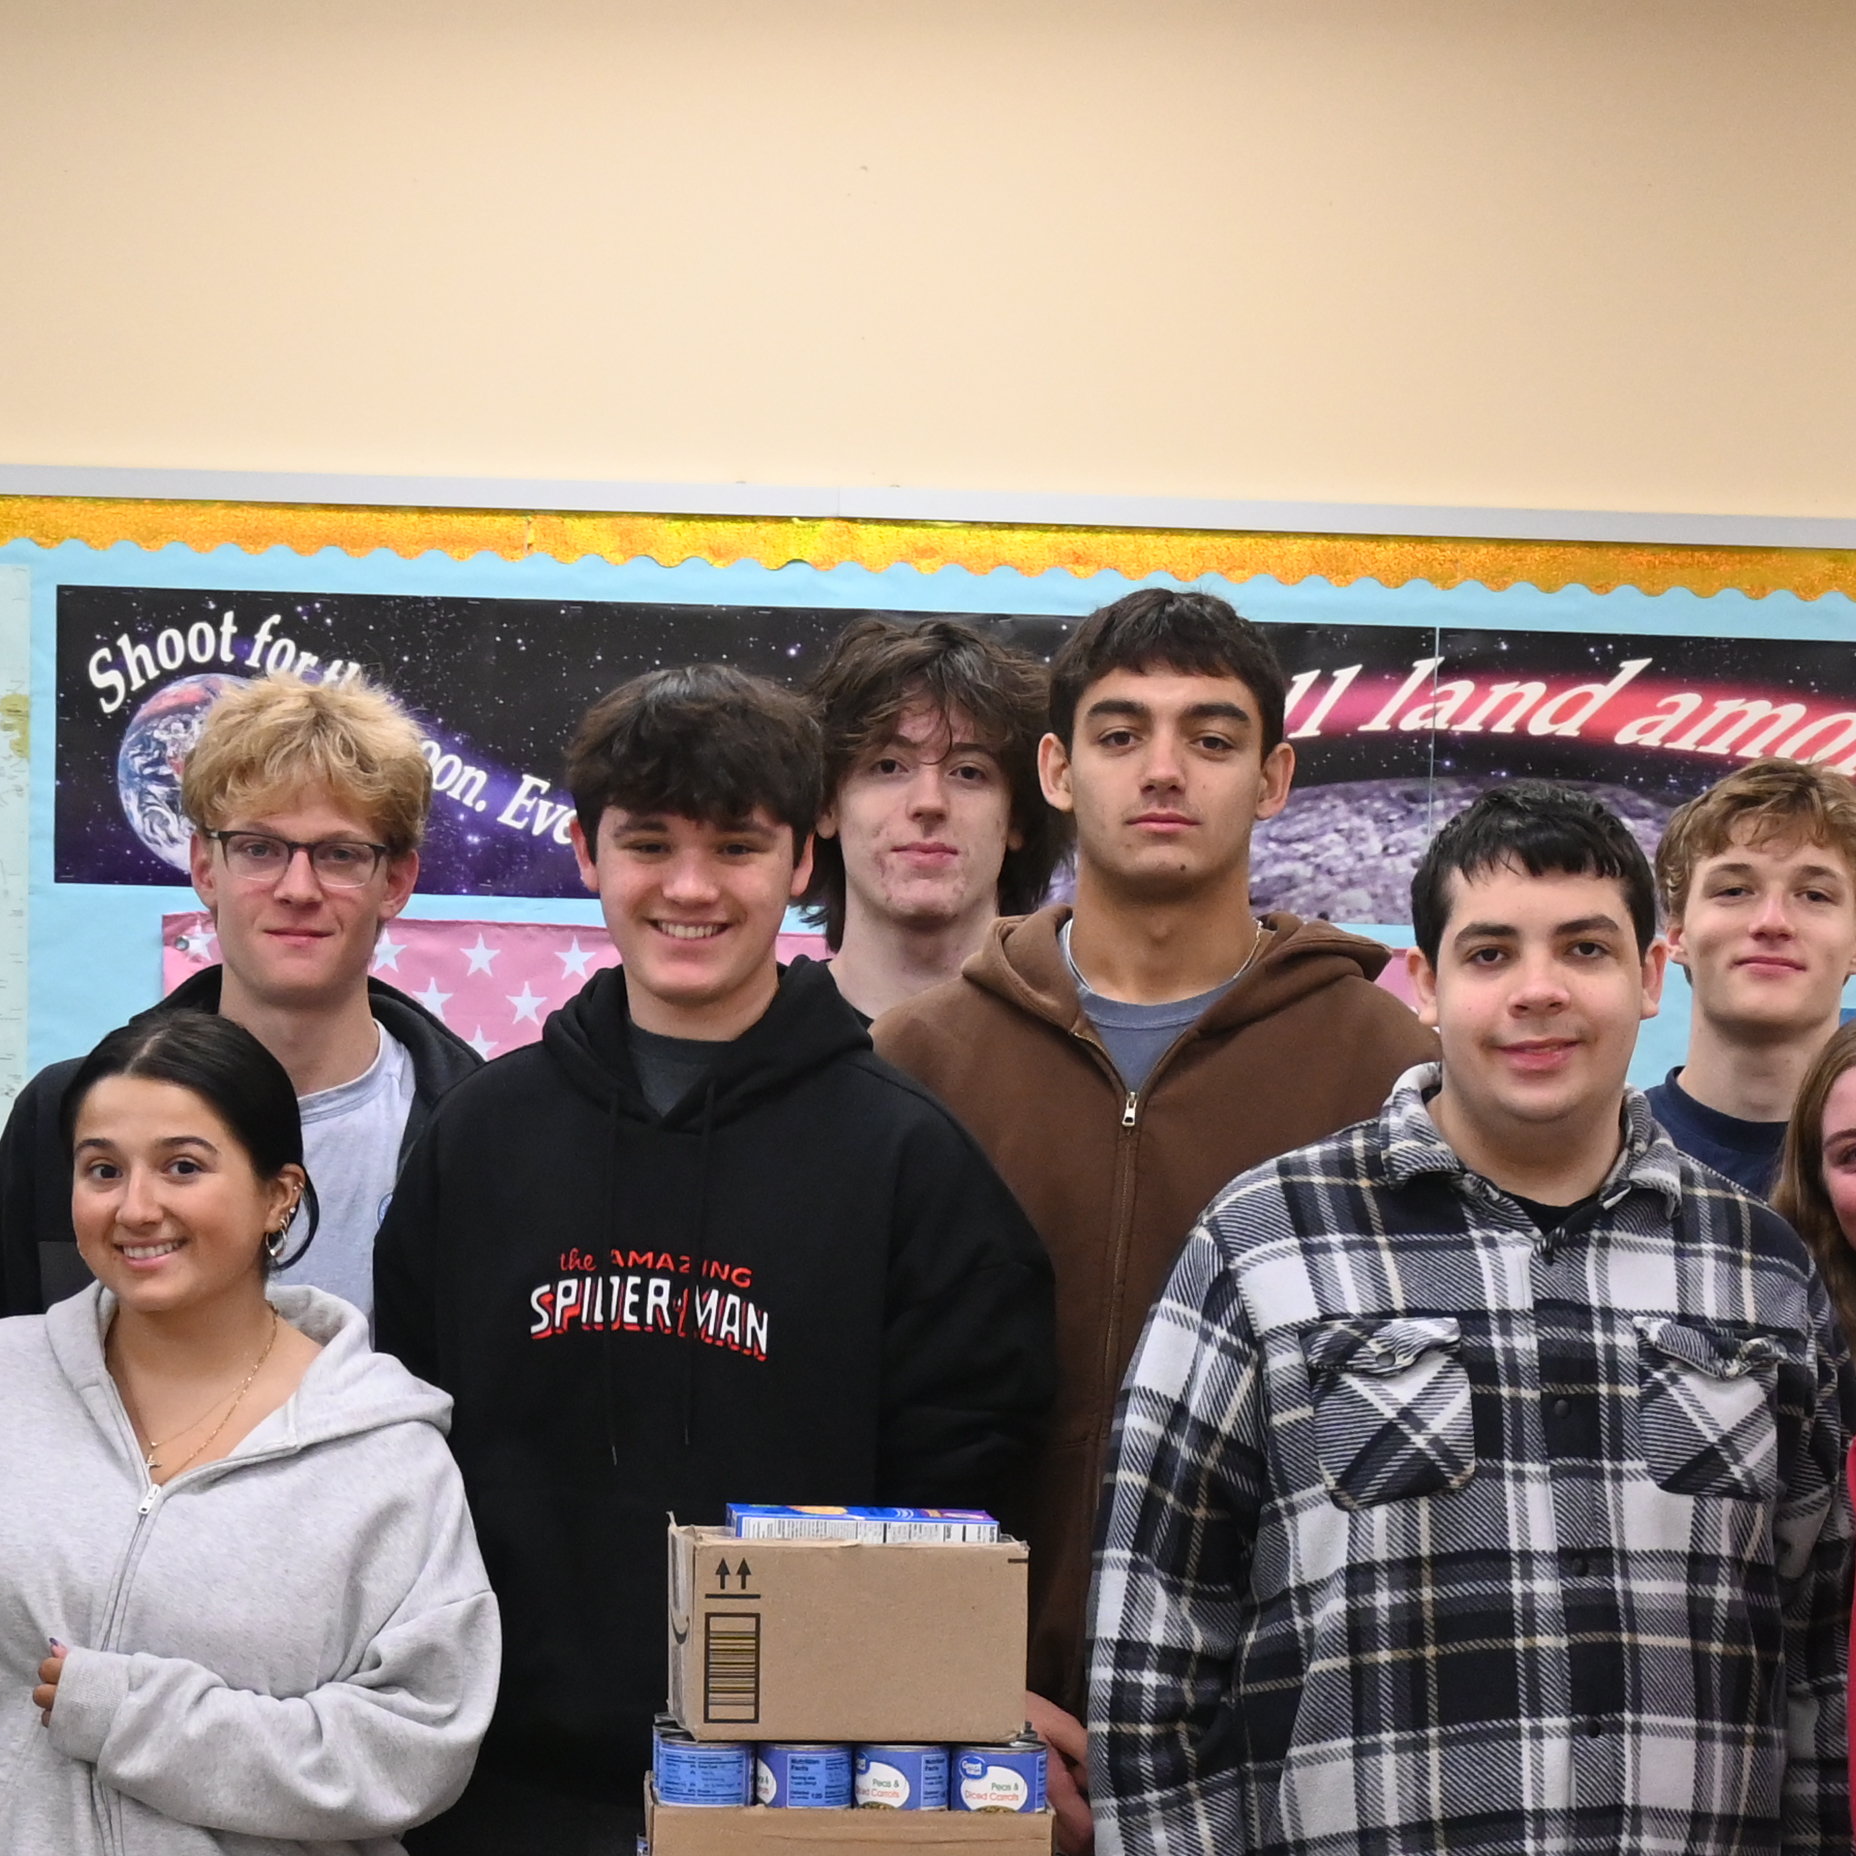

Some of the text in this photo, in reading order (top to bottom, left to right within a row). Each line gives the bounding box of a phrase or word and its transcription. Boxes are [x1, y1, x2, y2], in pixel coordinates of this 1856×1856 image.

[88, 610, 238, 714] Shoot
[245, 614, 318, 678] for
[1358, 657, 1652, 737] land
[560, 1247, 595, 1271] the
[872, 1778, 892, 1789] Peas
[991, 1781, 1019, 1792] Peas &
[964, 1789, 1020, 1802] Diced Carrots
